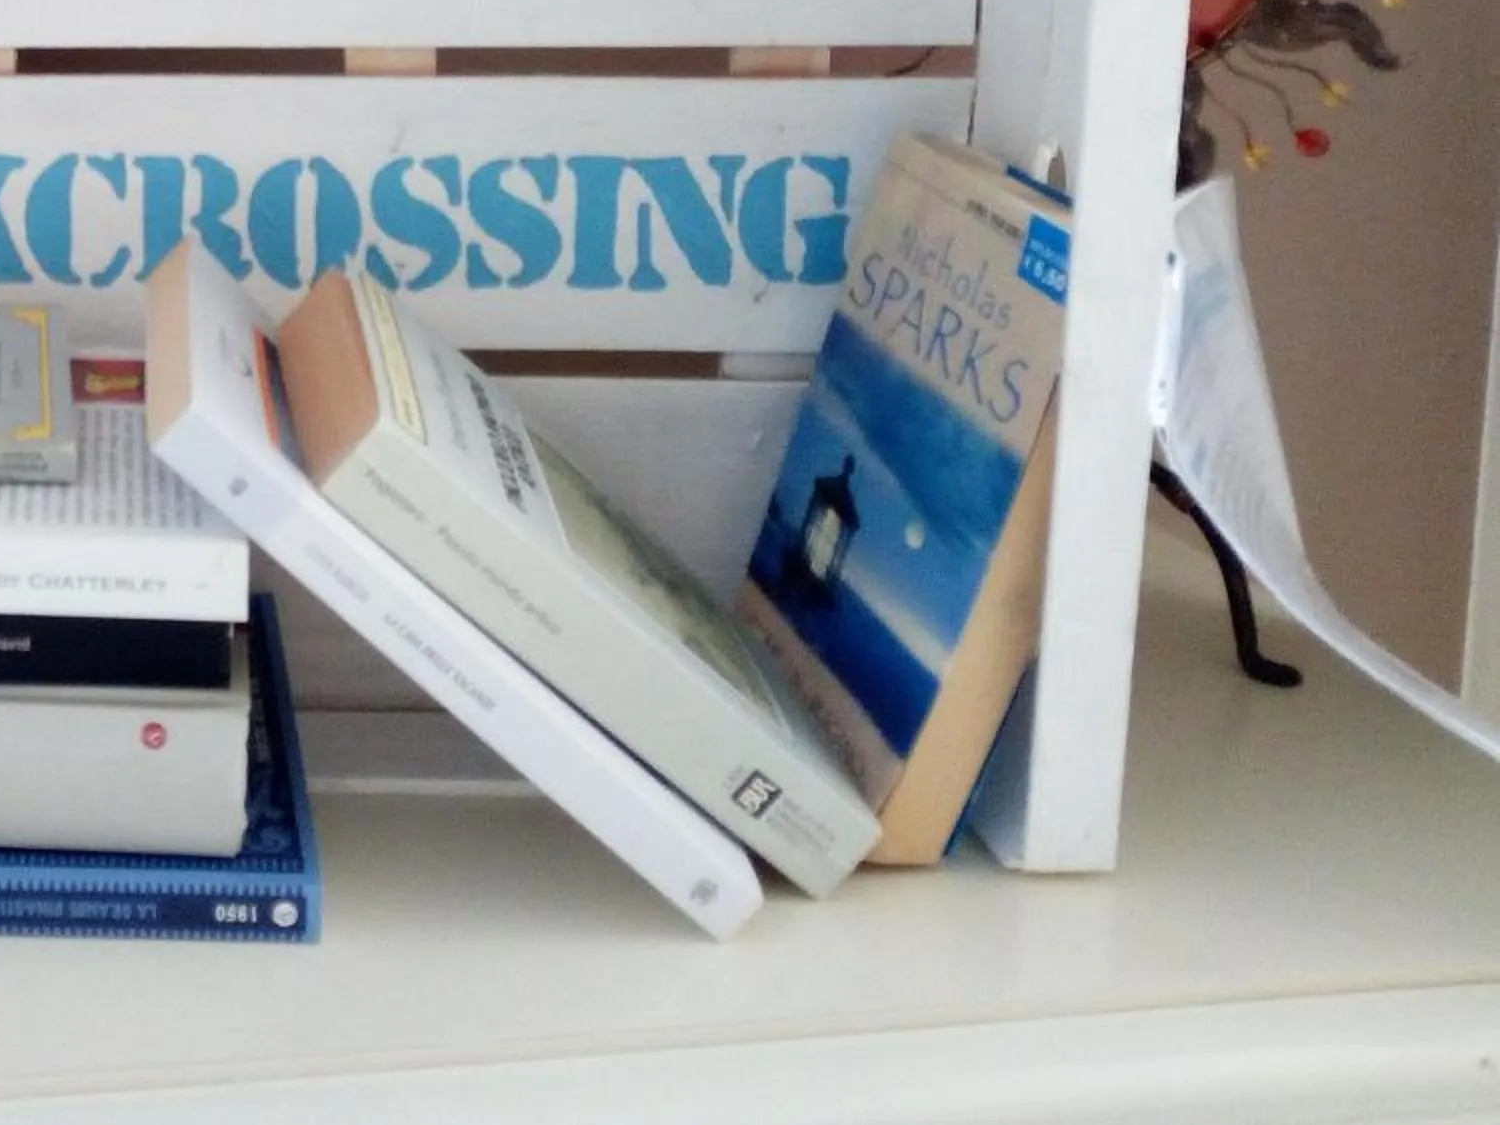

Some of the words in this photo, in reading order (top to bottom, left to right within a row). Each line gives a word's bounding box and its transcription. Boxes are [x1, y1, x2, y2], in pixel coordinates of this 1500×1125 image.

[901, 224, 1013, 330] Nicholas
[849, 252, 1030, 424] SPARKS
[29, 573, 167, 593] CHATTERLEY
